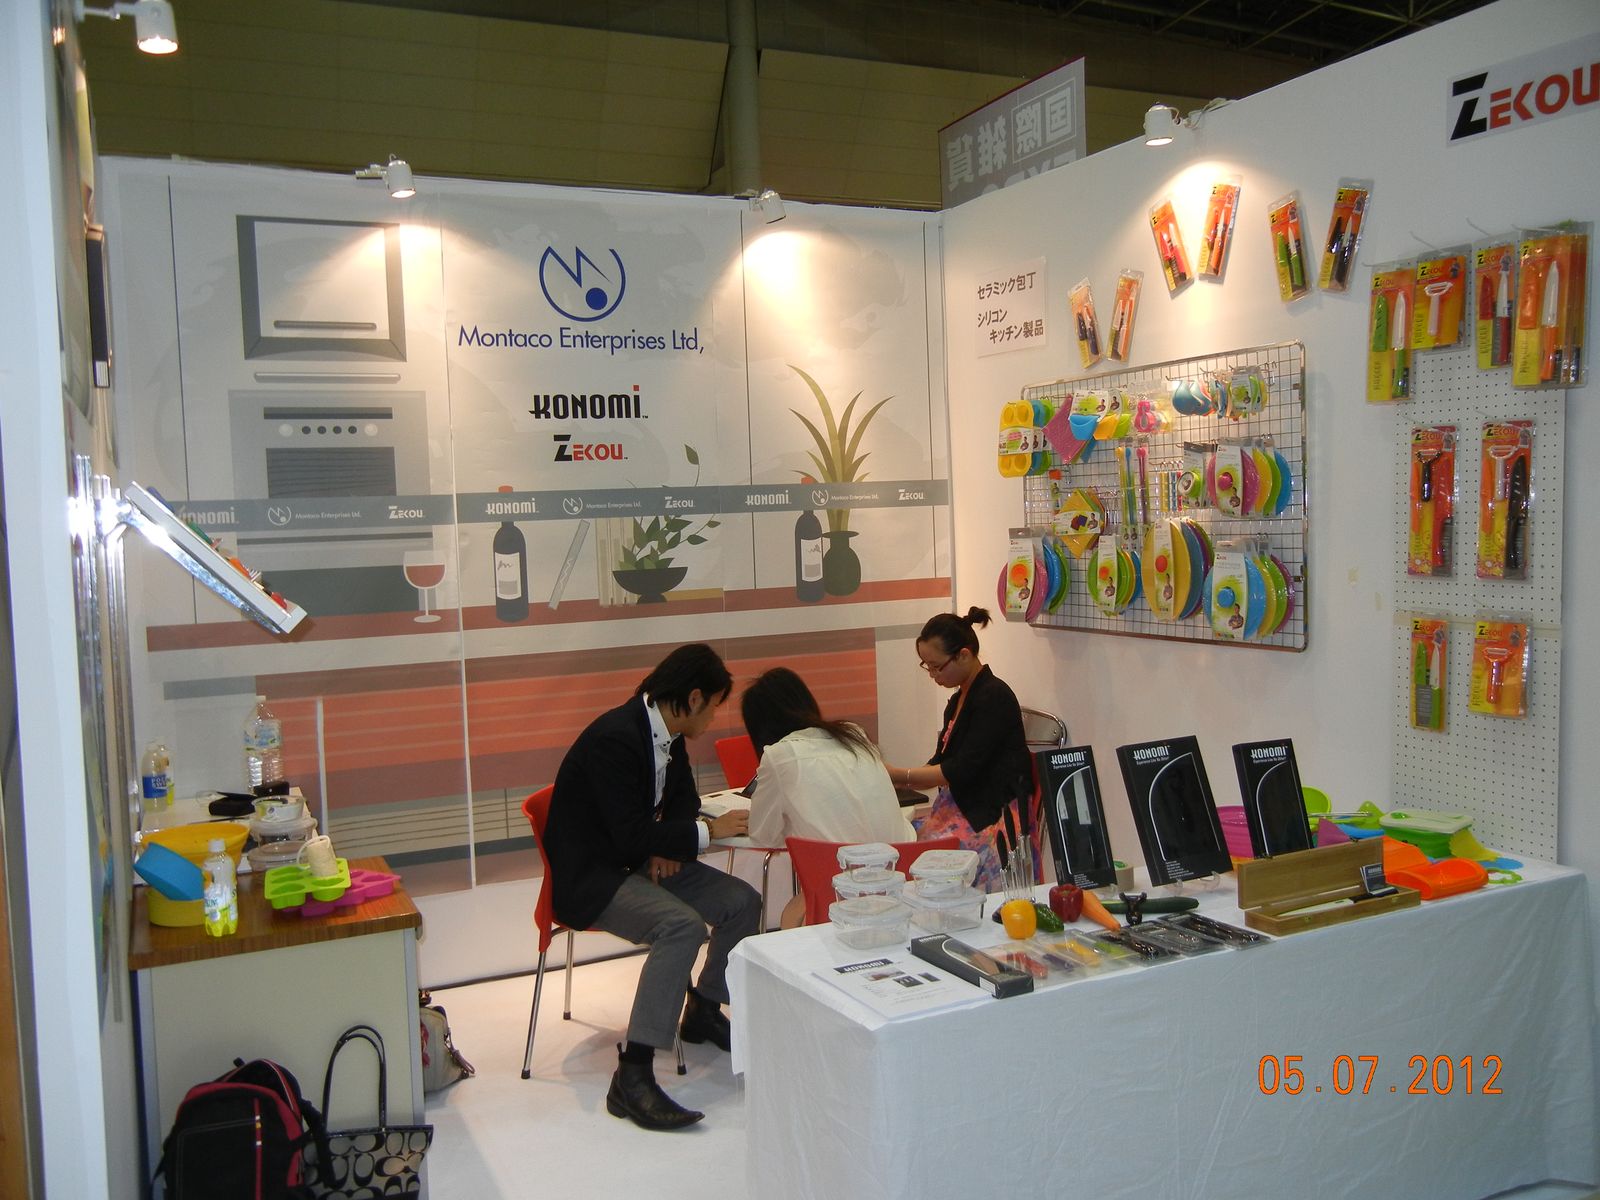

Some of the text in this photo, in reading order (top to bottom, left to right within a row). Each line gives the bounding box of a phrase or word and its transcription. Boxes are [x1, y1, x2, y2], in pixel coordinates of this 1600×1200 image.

[977, 271, 1036, 300] セラミック包丁
[977, 308, 1008, 328] シリコン
[989, 319, 1044, 344] キッチン製品
[458, 325, 553, 348] Montaco
[559, 327, 666, 355] Enterprises
[553, 434, 623, 461] ZEKOU
